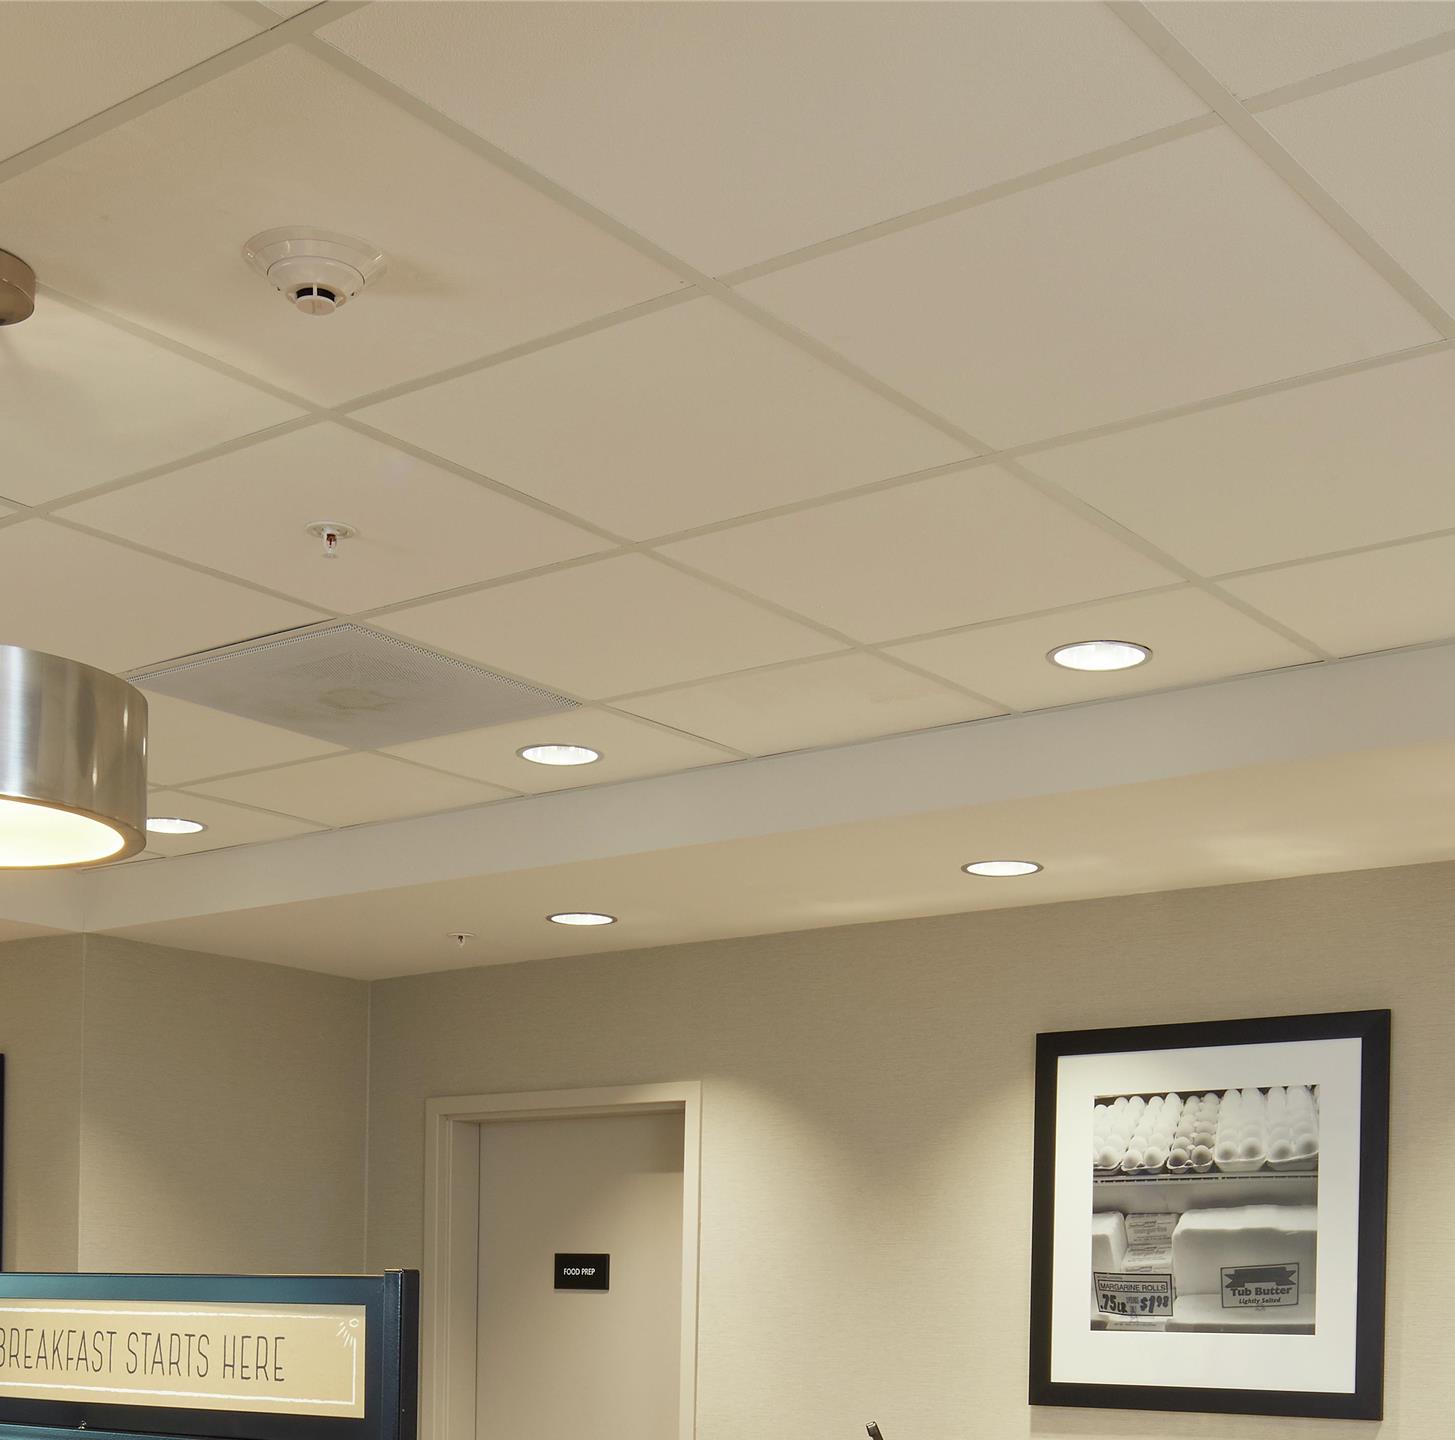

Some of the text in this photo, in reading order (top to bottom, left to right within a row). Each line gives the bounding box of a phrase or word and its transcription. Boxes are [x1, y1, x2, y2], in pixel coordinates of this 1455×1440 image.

[563, 1267, 596, 1276] FOOD PREP
[1100, 1282, 1166, 1292] MARGARINE ROLLS
[1230, 1286, 1293, 1297] Tub Butter
[126, 1331, 210, 1379] STARTS
[222, 1335, 286, 1382] HERE
